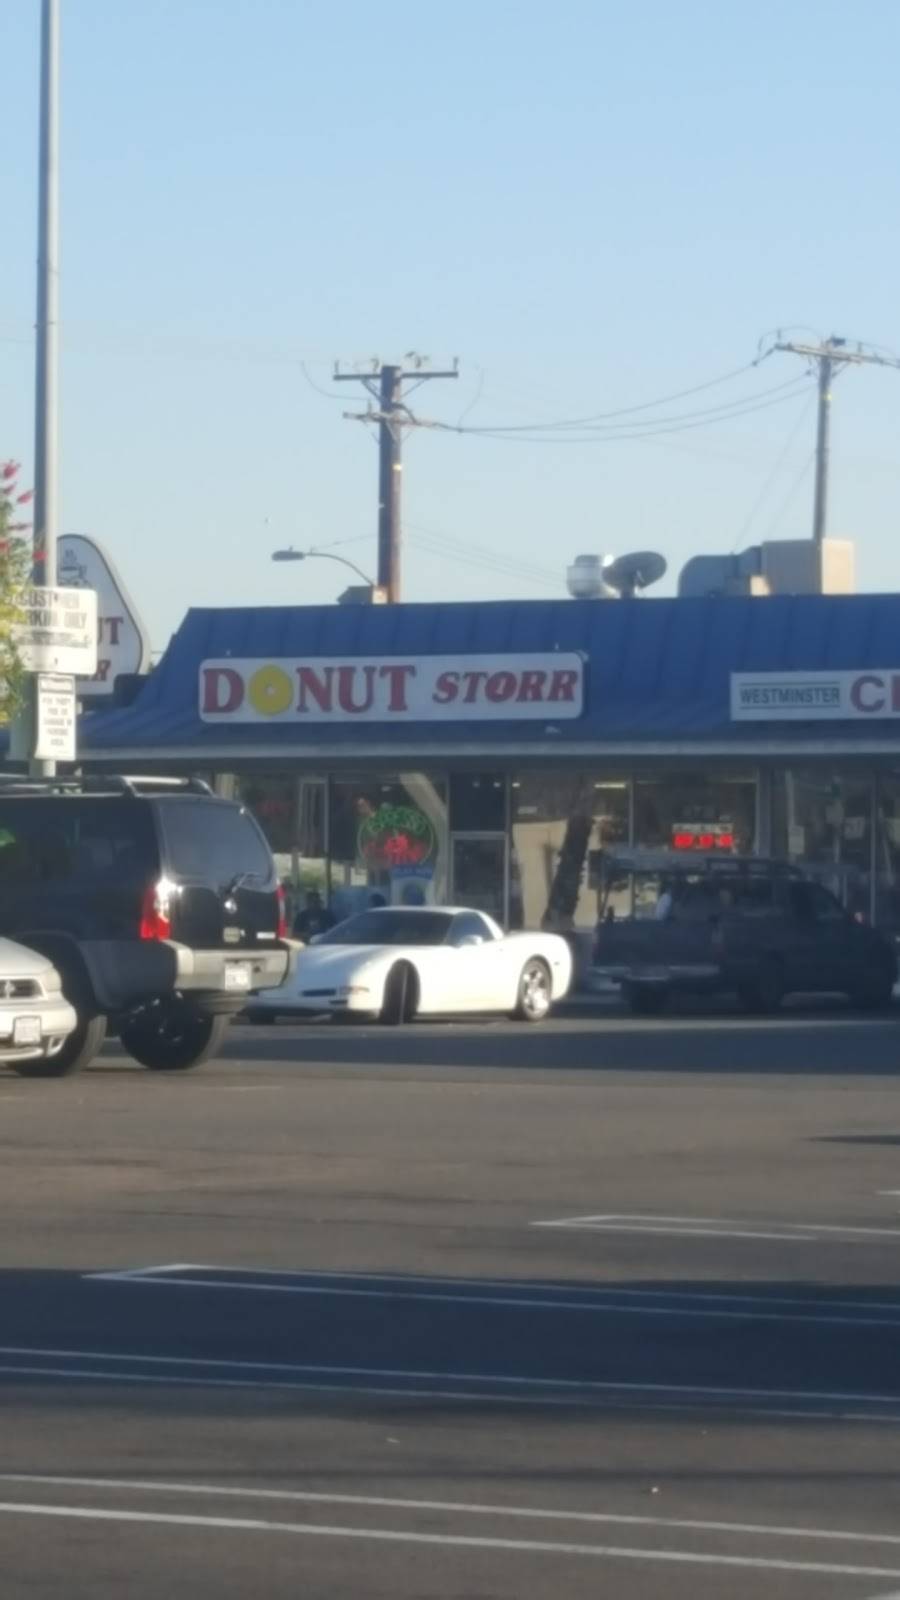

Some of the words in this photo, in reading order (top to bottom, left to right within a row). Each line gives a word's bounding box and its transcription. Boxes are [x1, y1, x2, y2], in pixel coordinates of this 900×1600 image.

[203, 664, 416, 716] DONUT
[432, 670, 578, 704] STORR
[739, 687, 840, 704] WESTMINSTER
